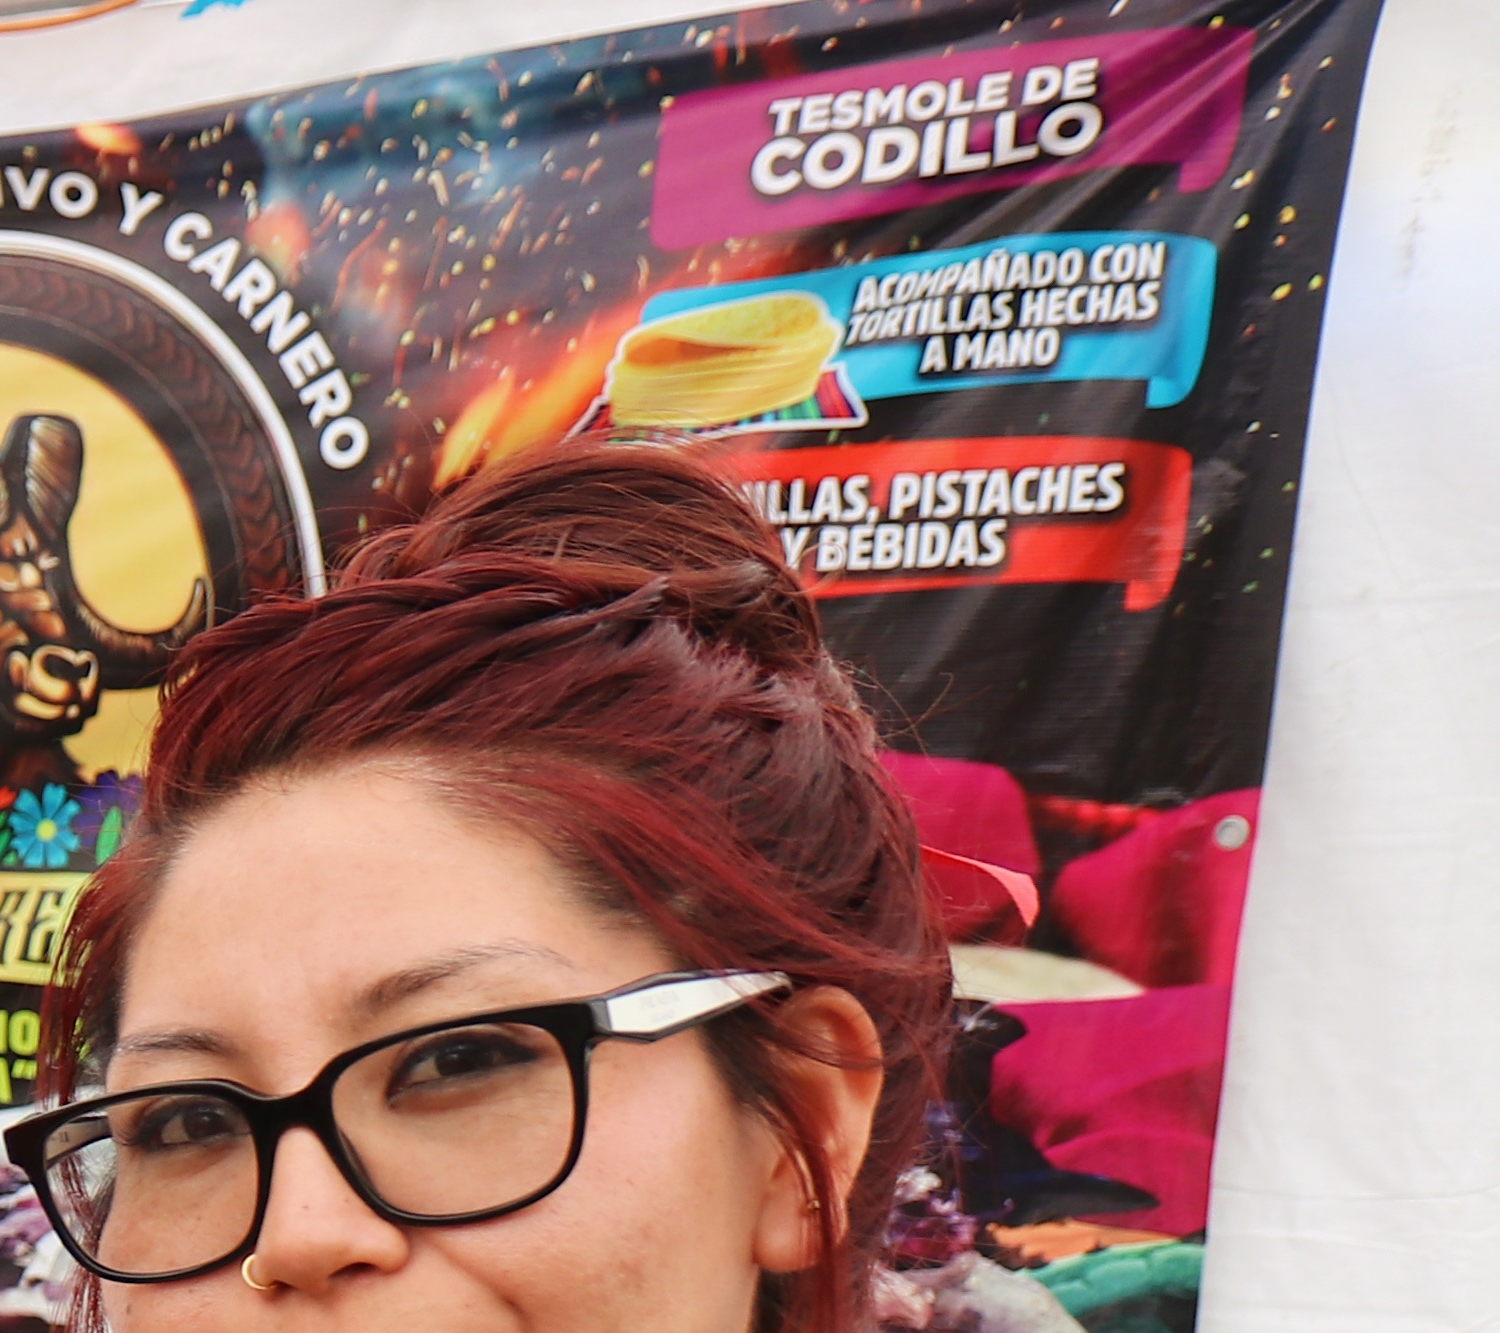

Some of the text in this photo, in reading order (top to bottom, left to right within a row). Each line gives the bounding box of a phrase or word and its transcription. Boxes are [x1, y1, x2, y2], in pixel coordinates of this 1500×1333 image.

[768, 57, 1099, 136] TESMOLE DE
[750, 104, 1103, 197] CODILLO
[854, 241, 1166, 311] ACOMPAÑADO CON
[116, 181, 164, 236] Y
[163, 212, 371, 472] CARNERO
[845, 284, 1160, 346] TORTILLAS HECHAS
[920, 327, 1061, 375] A MANO
[888, 461, 1126, 522] PISTACHES
[780, 518, 1008, 573] Y BEBIDAS
